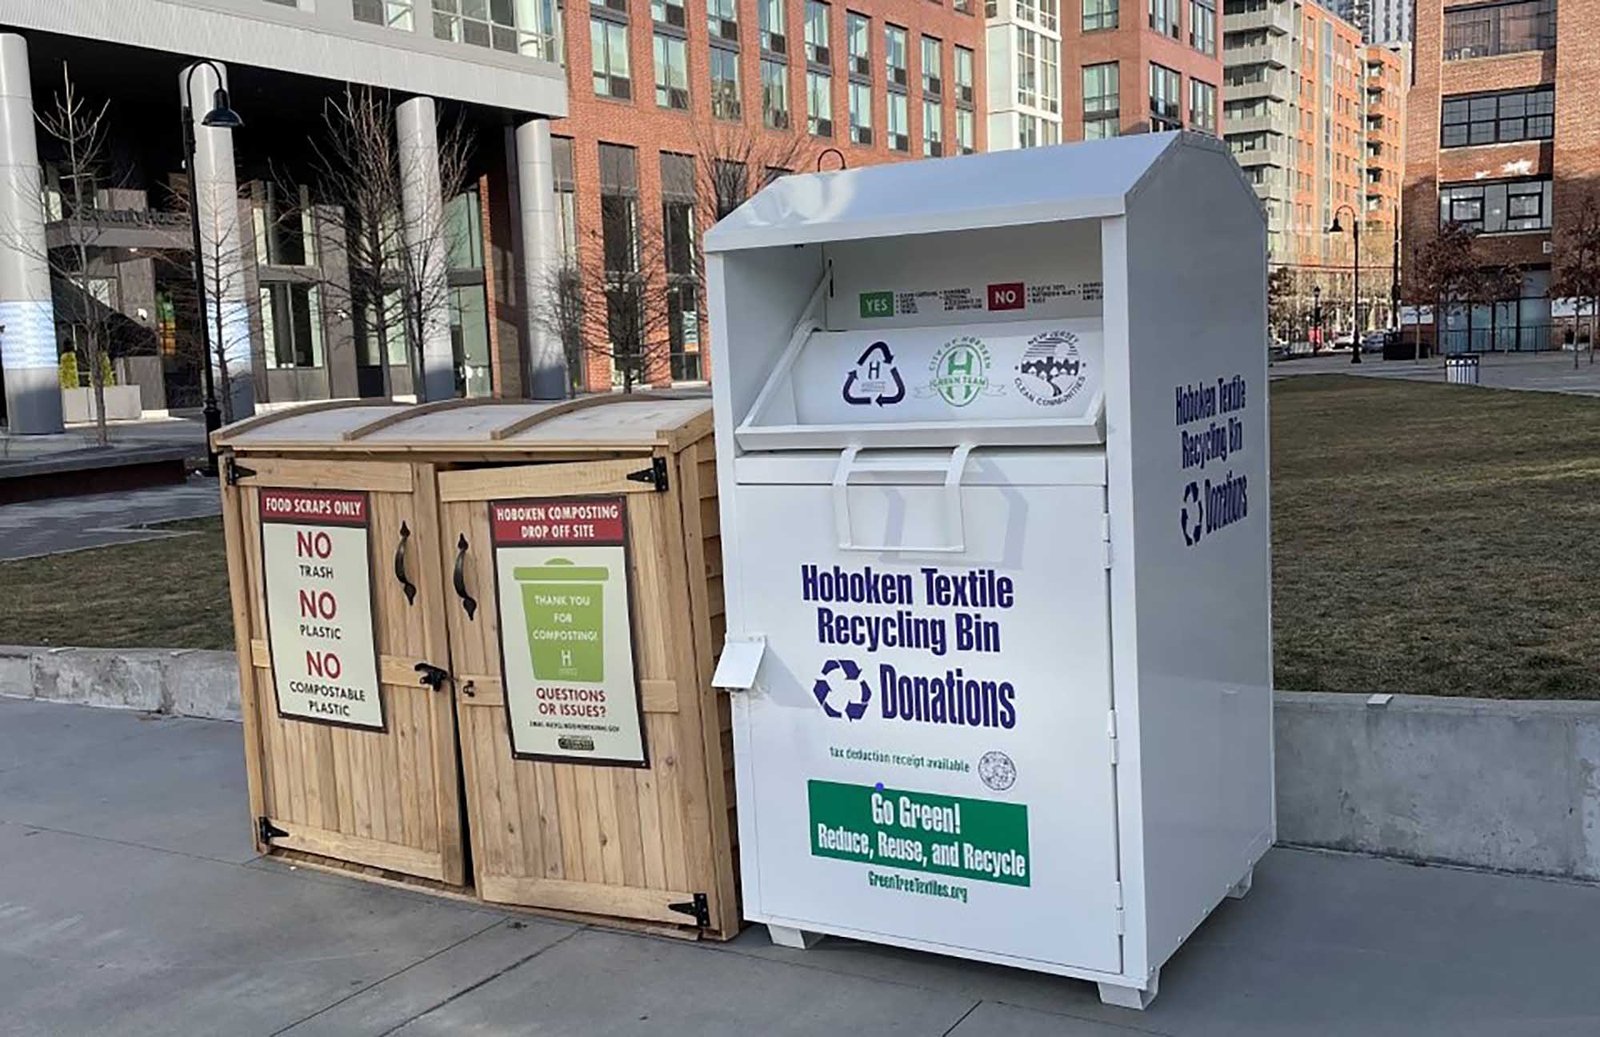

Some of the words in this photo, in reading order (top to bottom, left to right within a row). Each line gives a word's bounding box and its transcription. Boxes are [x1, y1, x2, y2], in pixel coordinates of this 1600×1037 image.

[866, 298, 888, 311] YES
[995, 290, 1015, 303] NO
[868, 361, 880, 379] H
[1014, 377, 1035, 402] CLEAN
[1175, 381, 1216, 426] Hoboken
[1217, 374, 1246, 414] Textile
[1181, 422, 1227, 469] Recycling
[1228, 416, 1242, 453] Bin
[266, 497, 292, 512] FOOD
[294, 499, 331, 514] SCRAPS
[334, 501, 361, 515] ONLY
[1204, 469, 1248, 534] Donations
[496, 507, 546, 521] HOBOKEN
[548, 505, 619, 520] COMPOSTING
[521, 525, 549, 538] DROP
[551, 525, 571, 538] OFF
[573, 524, 595, 538] SITE
[297, 531, 332, 559] NO
[299, 565, 334, 579] TRASH
[801, 564, 913, 605] Hoboken
[921, 568, 1014, 608] Textile
[299, 589, 337, 619] NO
[534, 595, 567, 605] THANK
[569, 596, 590, 606] YOU
[554, 613, 572, 623] FOR
[300, 625, 341, 639] PLASTIC
[532, 630, 598, 641] COMPOSTING!
[817, 607, 947, 656] Recycling
[955, 613, 1000, 652] Bin
[306, 650, 341, 679] NO
[561, 649, 572, 666] H
[289, 681, 366, 702] COMPOSTABLE
[536, 688, 606, 702] QUESTIONS
[880, 664, 1016, 729] Donations
[308, 700, 350, 716] PLASTIC
[538, 703, 556, 715] OR
[560, 704, 607, 718] ISSUES?
[830, 746, 844, 758] tax
[846, 748, 891, 763] deduction
[892, 753, 925, 768] receipt
[927, 757, 970, 773] available
[871, 793, 894, 825] Go
[899, 796, 961, 834] Green!
[818, 823, 873, 859] Reduce,
[878, 831, 927, 867] Reuse,
[932, 841, 959, 867] and
[963, 843, 1025, 877] Recycle
[868, 871, 968, 903] GreenTreeTextiles.org
